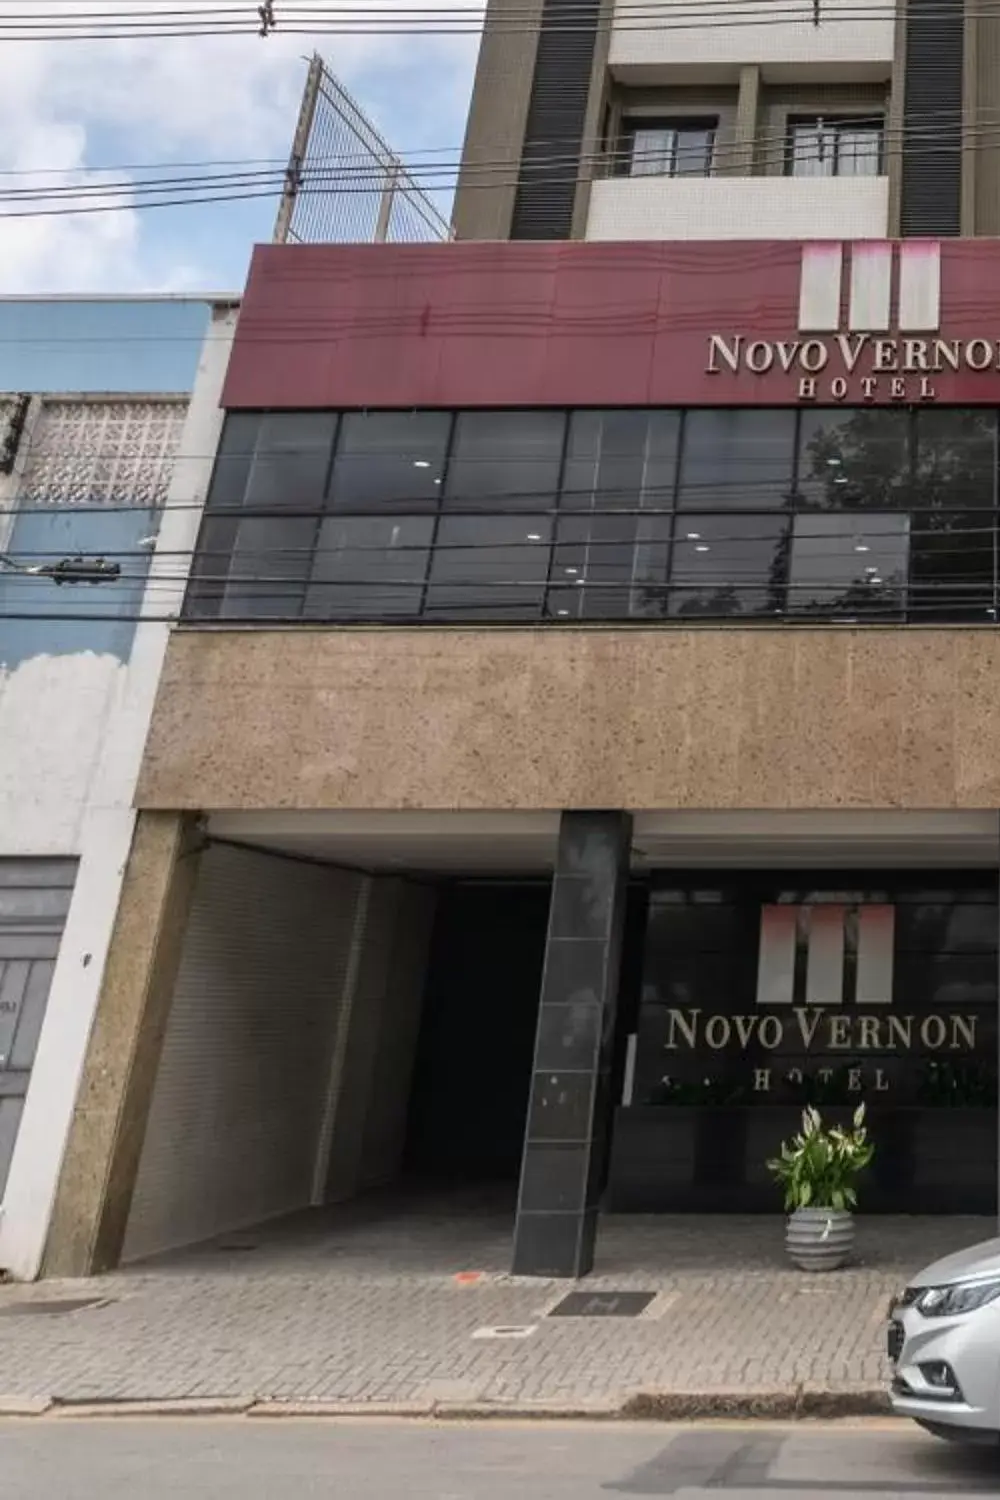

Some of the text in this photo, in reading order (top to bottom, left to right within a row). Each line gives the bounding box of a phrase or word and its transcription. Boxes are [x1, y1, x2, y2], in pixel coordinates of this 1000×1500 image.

[705, 334, 828, 373] NOVO
[798, 377, 935, 398] HOTEL
[664, 1007, 979, 1050] NOVO VERNON
[753, 1067, 889, 1091] HOTEL
